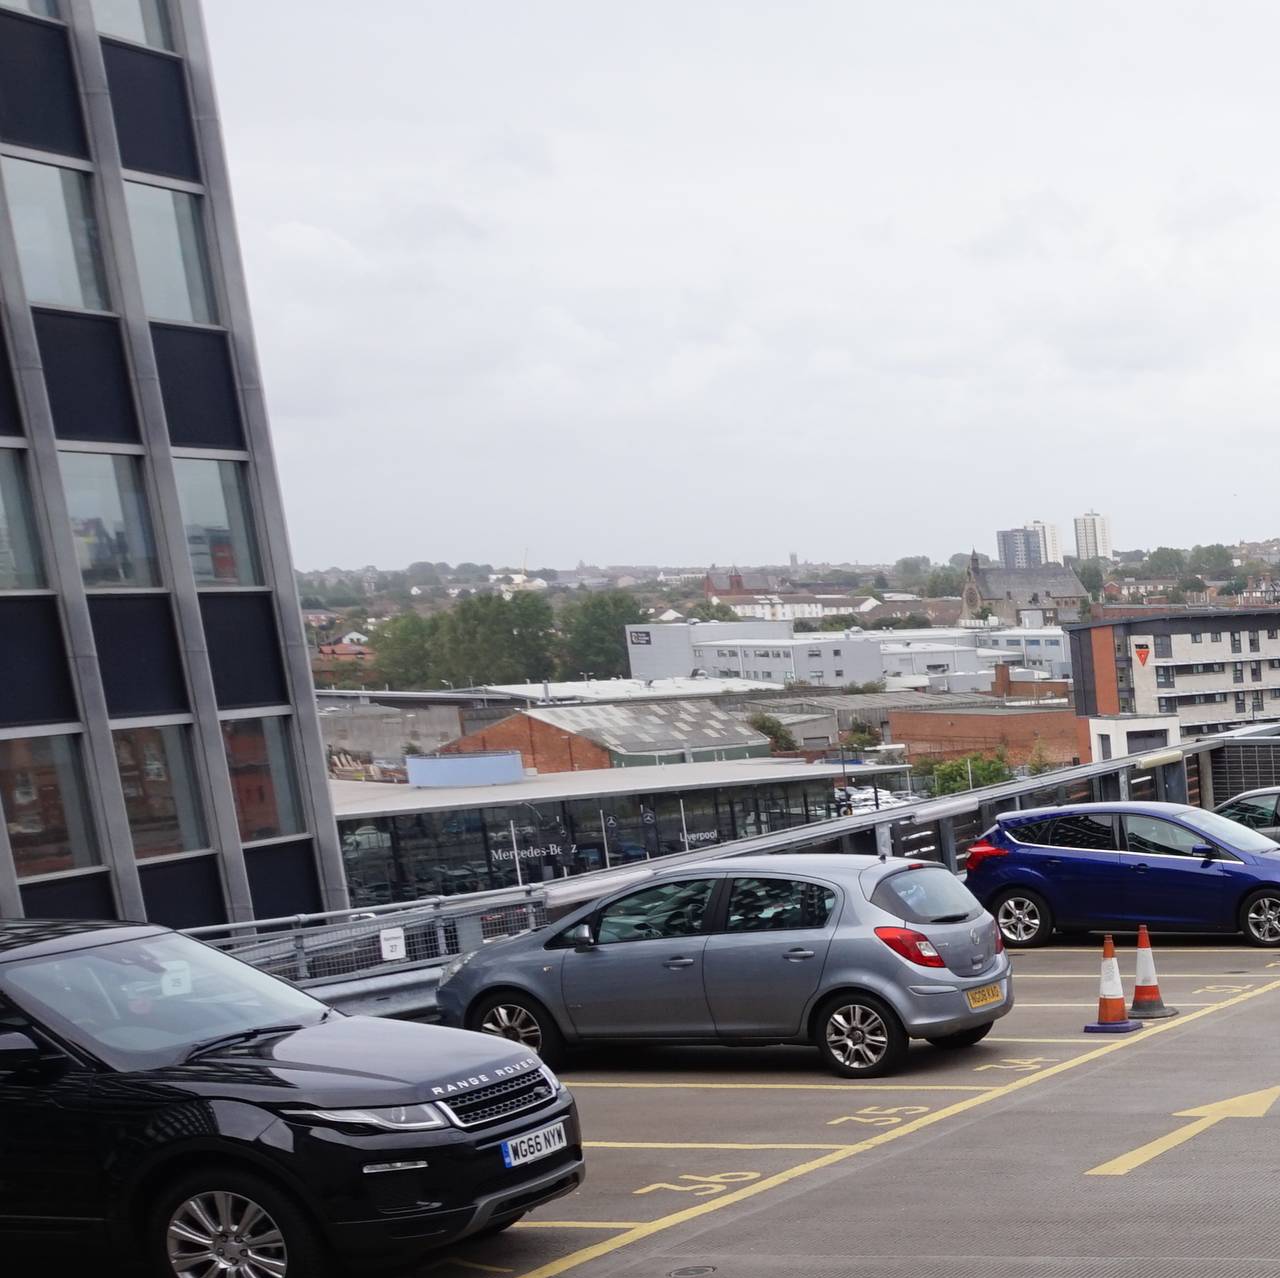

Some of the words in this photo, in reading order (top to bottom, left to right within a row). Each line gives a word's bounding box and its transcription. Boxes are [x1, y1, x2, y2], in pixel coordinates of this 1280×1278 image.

[679, 829, 718, 842] Lverpool
[973, 1056, 1060, 1072] 34
[431, 1074, 489, 1095] RANGE
[495, 1058, 535, 1077] ROVER
[826, 1106, 931, 1126] 35
[510, 1135, 542, 1162] WG66
[543, 1125, 564, 1147] NYW
[632, 1171, 761, 1196] 36
